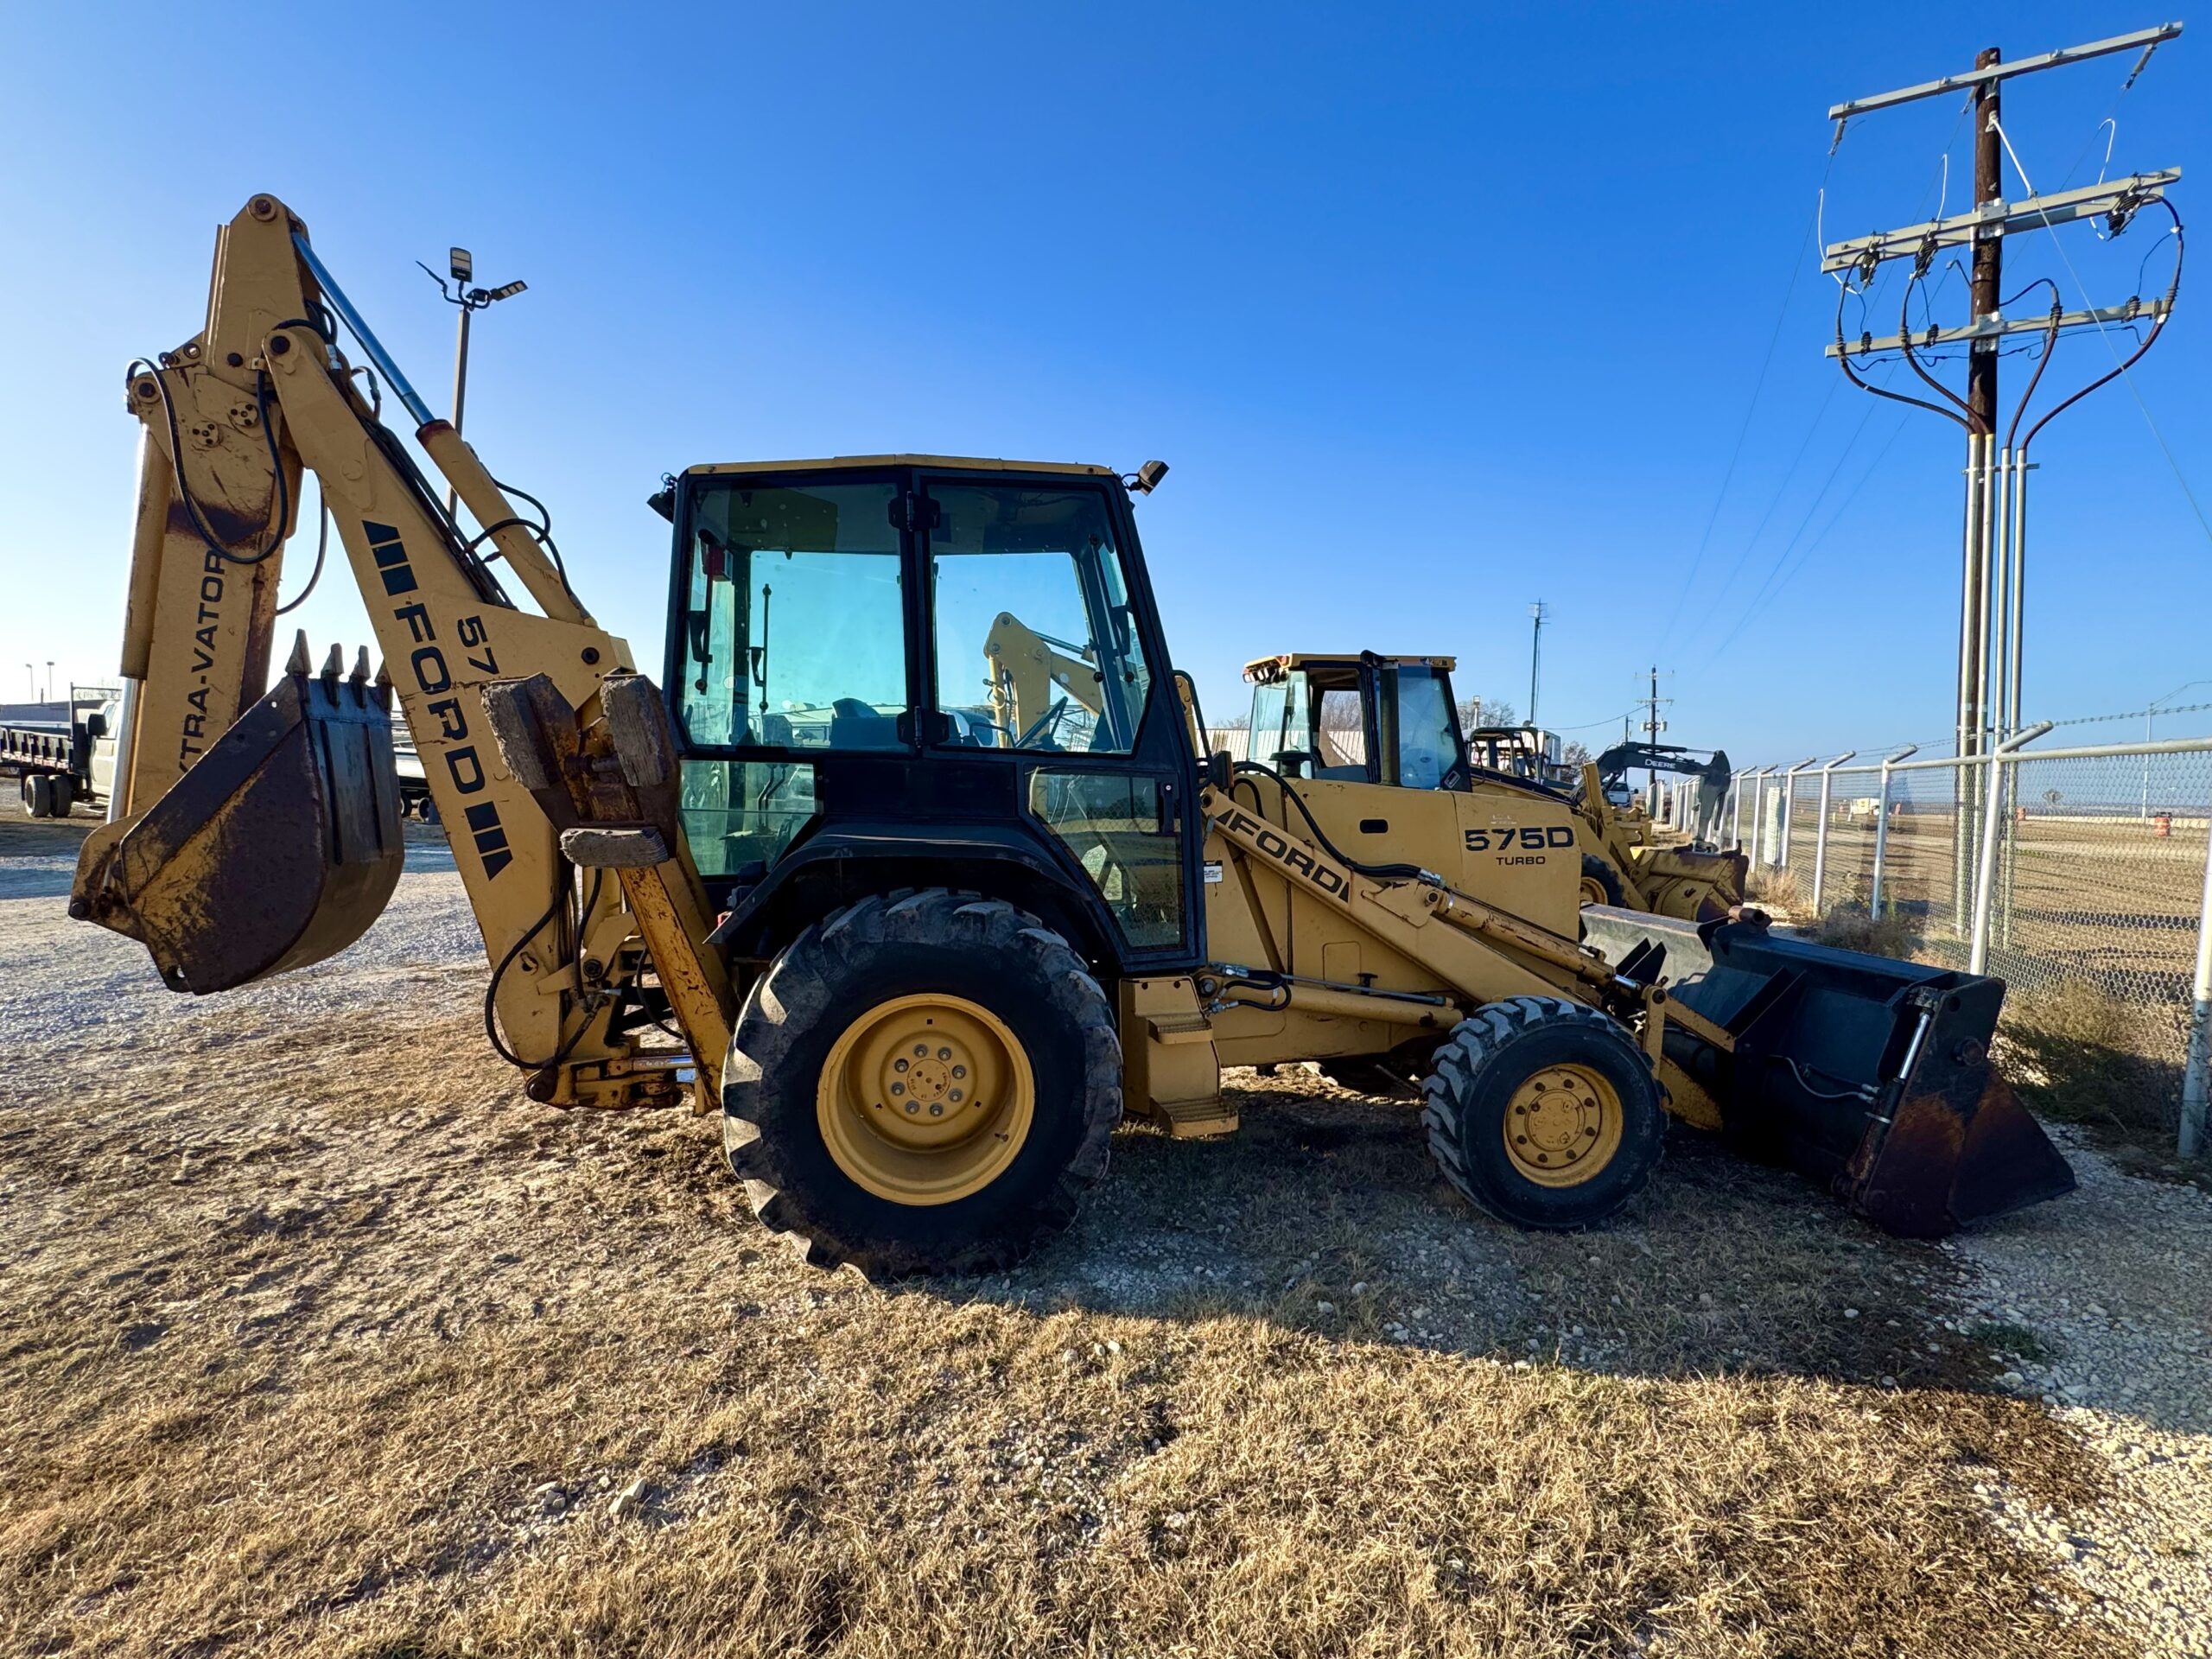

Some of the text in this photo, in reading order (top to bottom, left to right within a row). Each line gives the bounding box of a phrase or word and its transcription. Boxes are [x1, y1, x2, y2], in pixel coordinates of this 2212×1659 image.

[178, 550, 226, 774] TRA-VATOR
[393, 602, 486, 795] FORD
[1644, 758, 1676, 769] DEERE
[1228, 811, 1343, 894] FORD
[1465, 826, 1574, 852] 575D
[1496, 855, 1546, 866] TURBO
